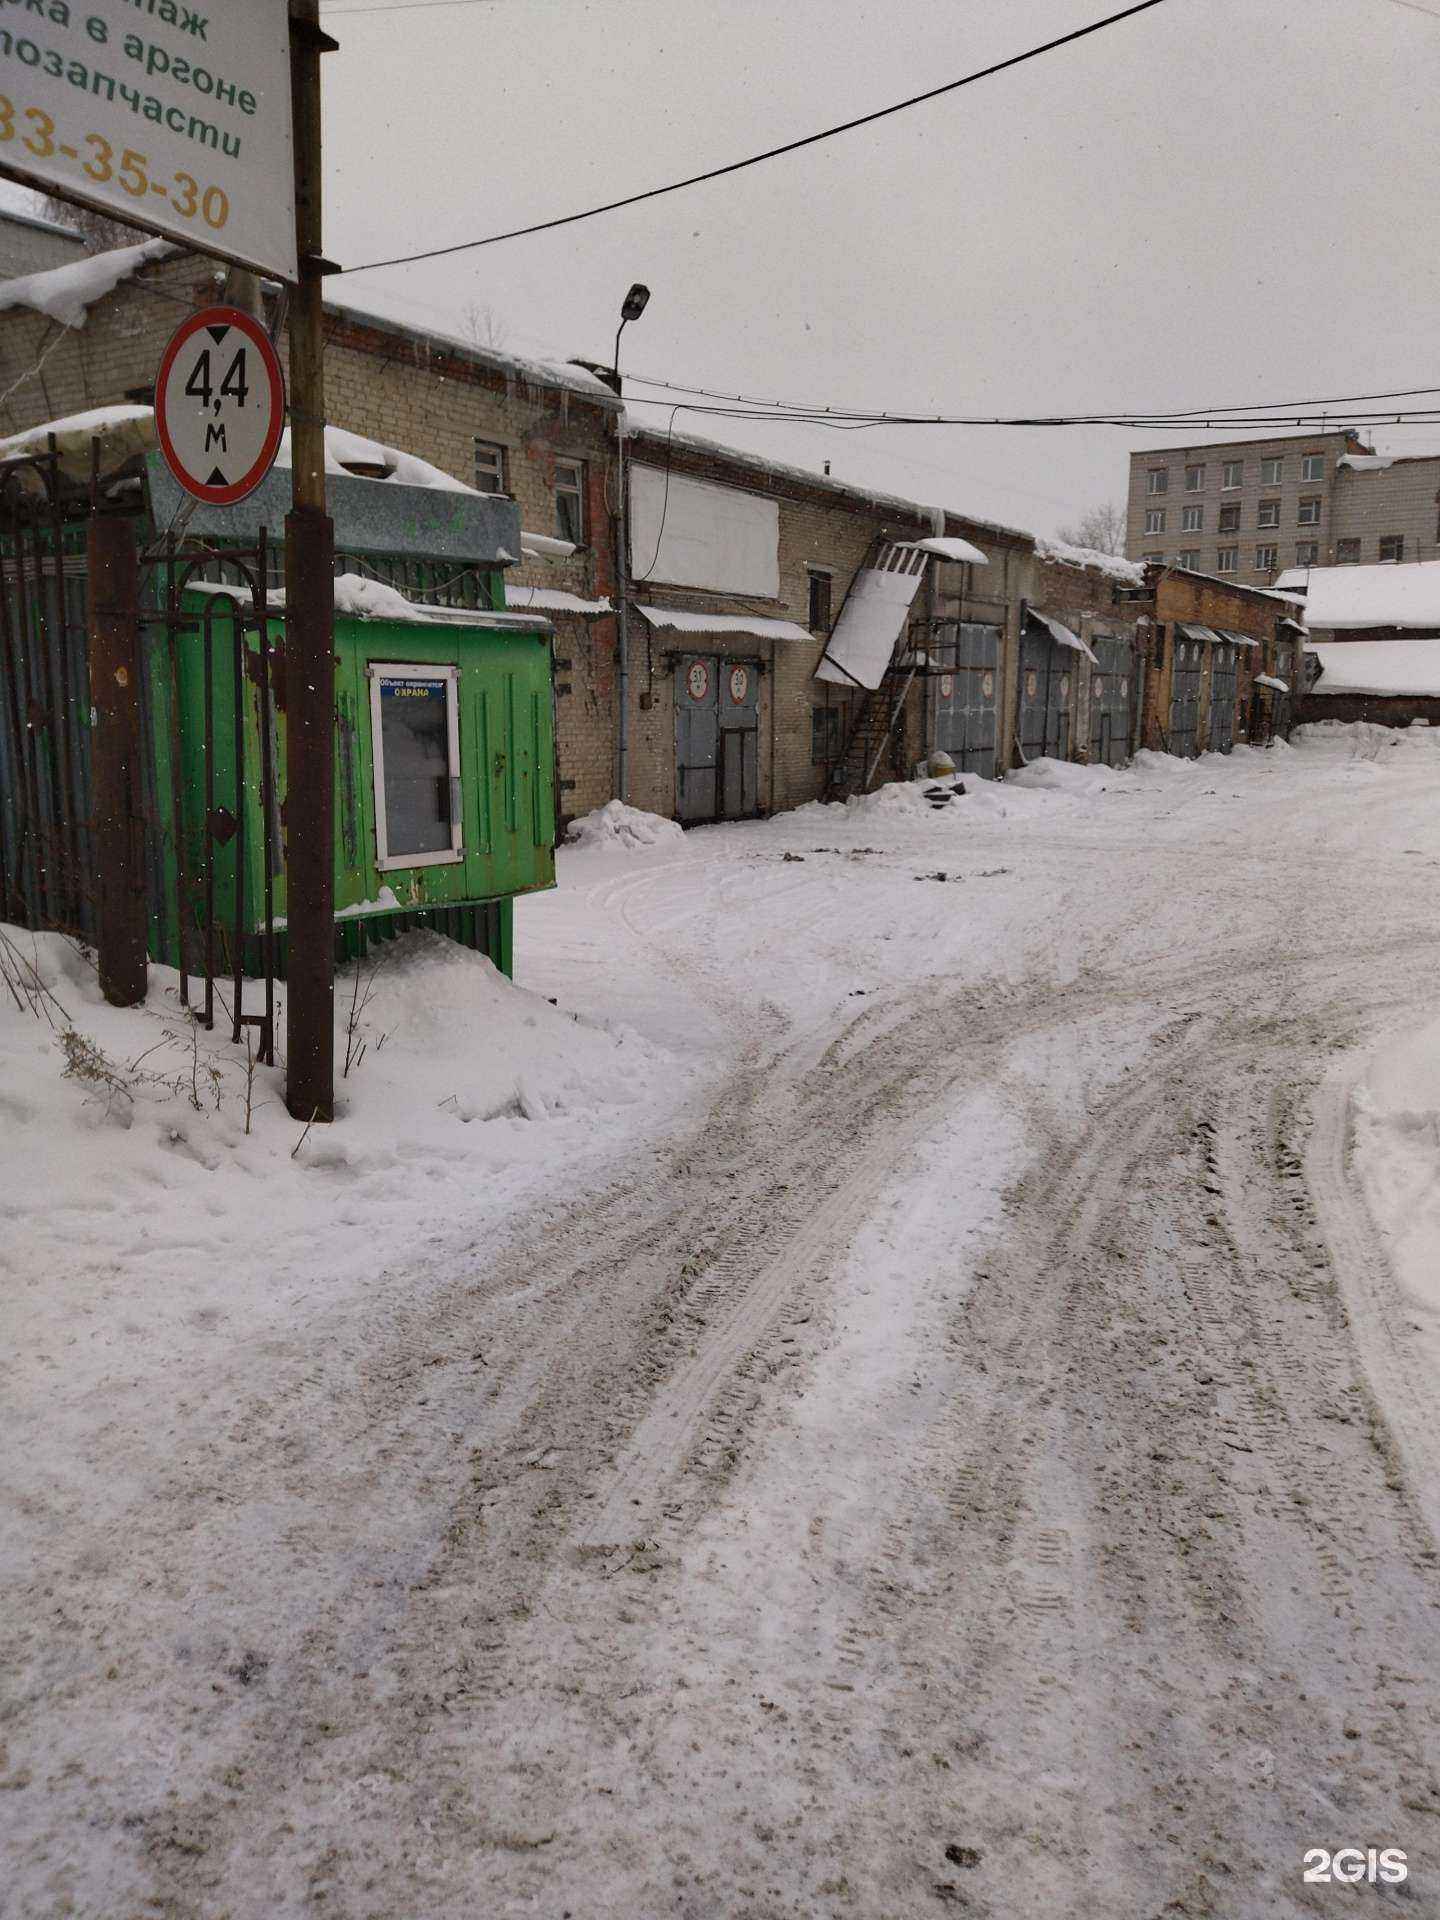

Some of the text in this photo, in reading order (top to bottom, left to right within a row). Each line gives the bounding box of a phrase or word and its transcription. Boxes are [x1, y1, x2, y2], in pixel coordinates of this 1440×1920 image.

[86, 16, 108, 43] в
[124, 33, 257, 115] аргоне
[185, 348, 249, 417] 4,4
[394, 688, 430, 697] ОХРАНА
